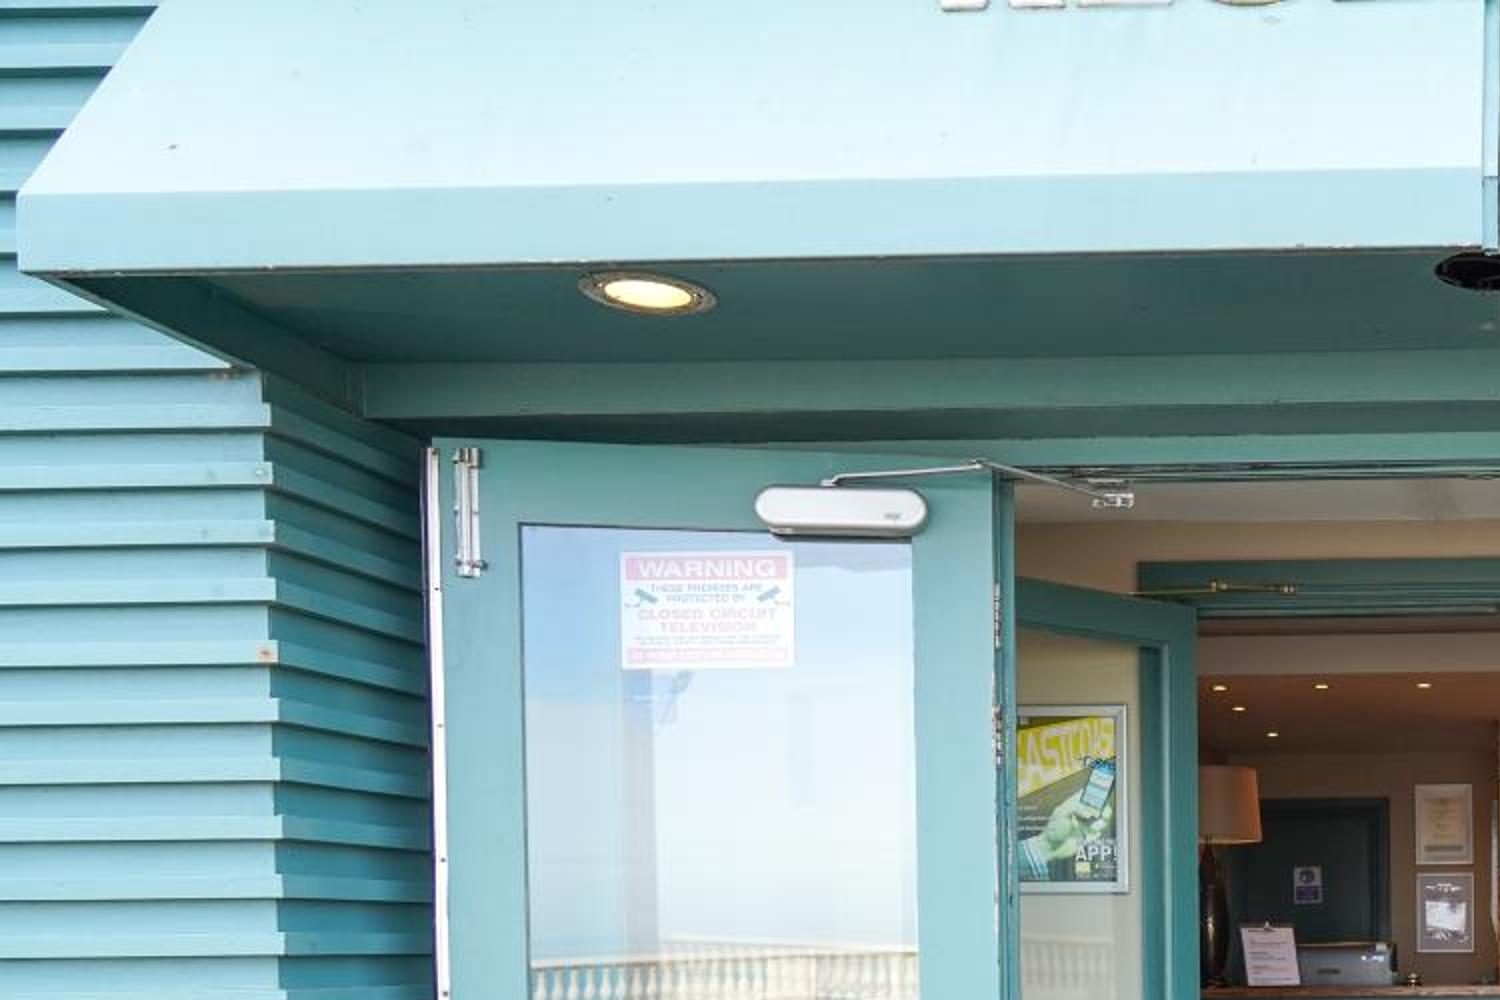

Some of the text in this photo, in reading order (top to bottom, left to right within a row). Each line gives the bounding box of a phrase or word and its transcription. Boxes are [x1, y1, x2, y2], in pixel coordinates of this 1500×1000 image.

[638, 559, 776, 577] WARNING
[637, 608, 777, 621] CLOSED CIRCUIT
[660, 622, 757, 633] TELEVISION
